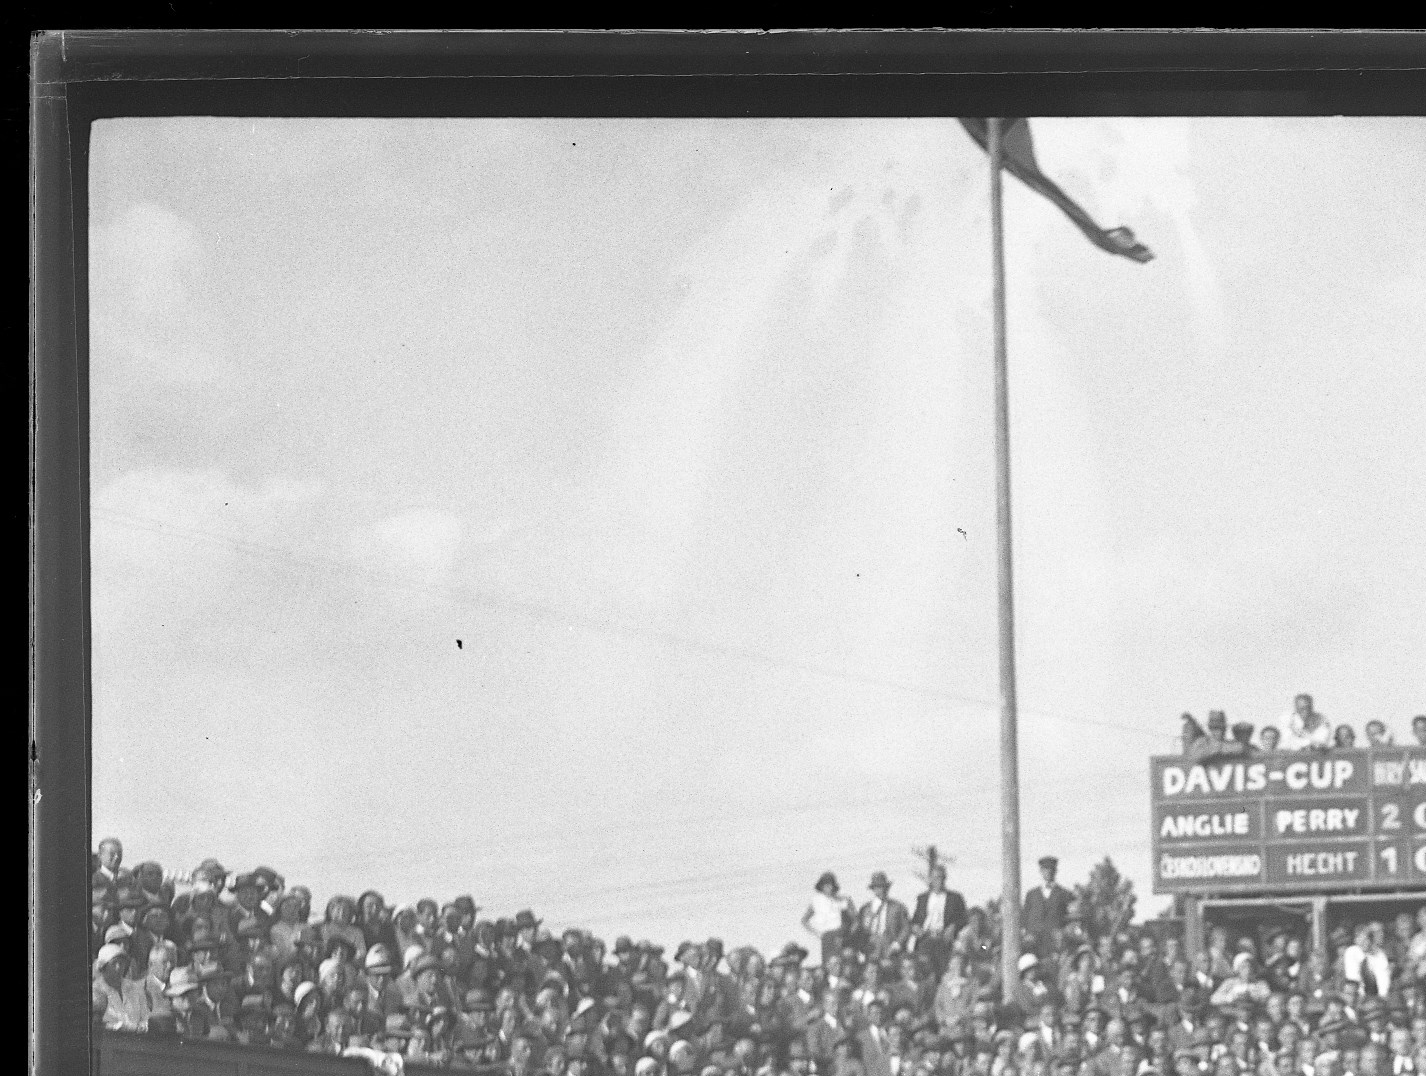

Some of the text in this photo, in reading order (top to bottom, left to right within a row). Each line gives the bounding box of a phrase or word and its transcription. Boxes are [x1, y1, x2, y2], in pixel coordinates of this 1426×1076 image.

[1162, 760, 1354, 796] DAVIS-CUP
[1160, 812, 1249, 837] ANGLIE
[1275, 808, 1360, 833] PERRY
[1380, 804, 1400, 829] 2
[1286, 851, 1358, 875] HECHT
[1381, 847, 1397, 873] 1
